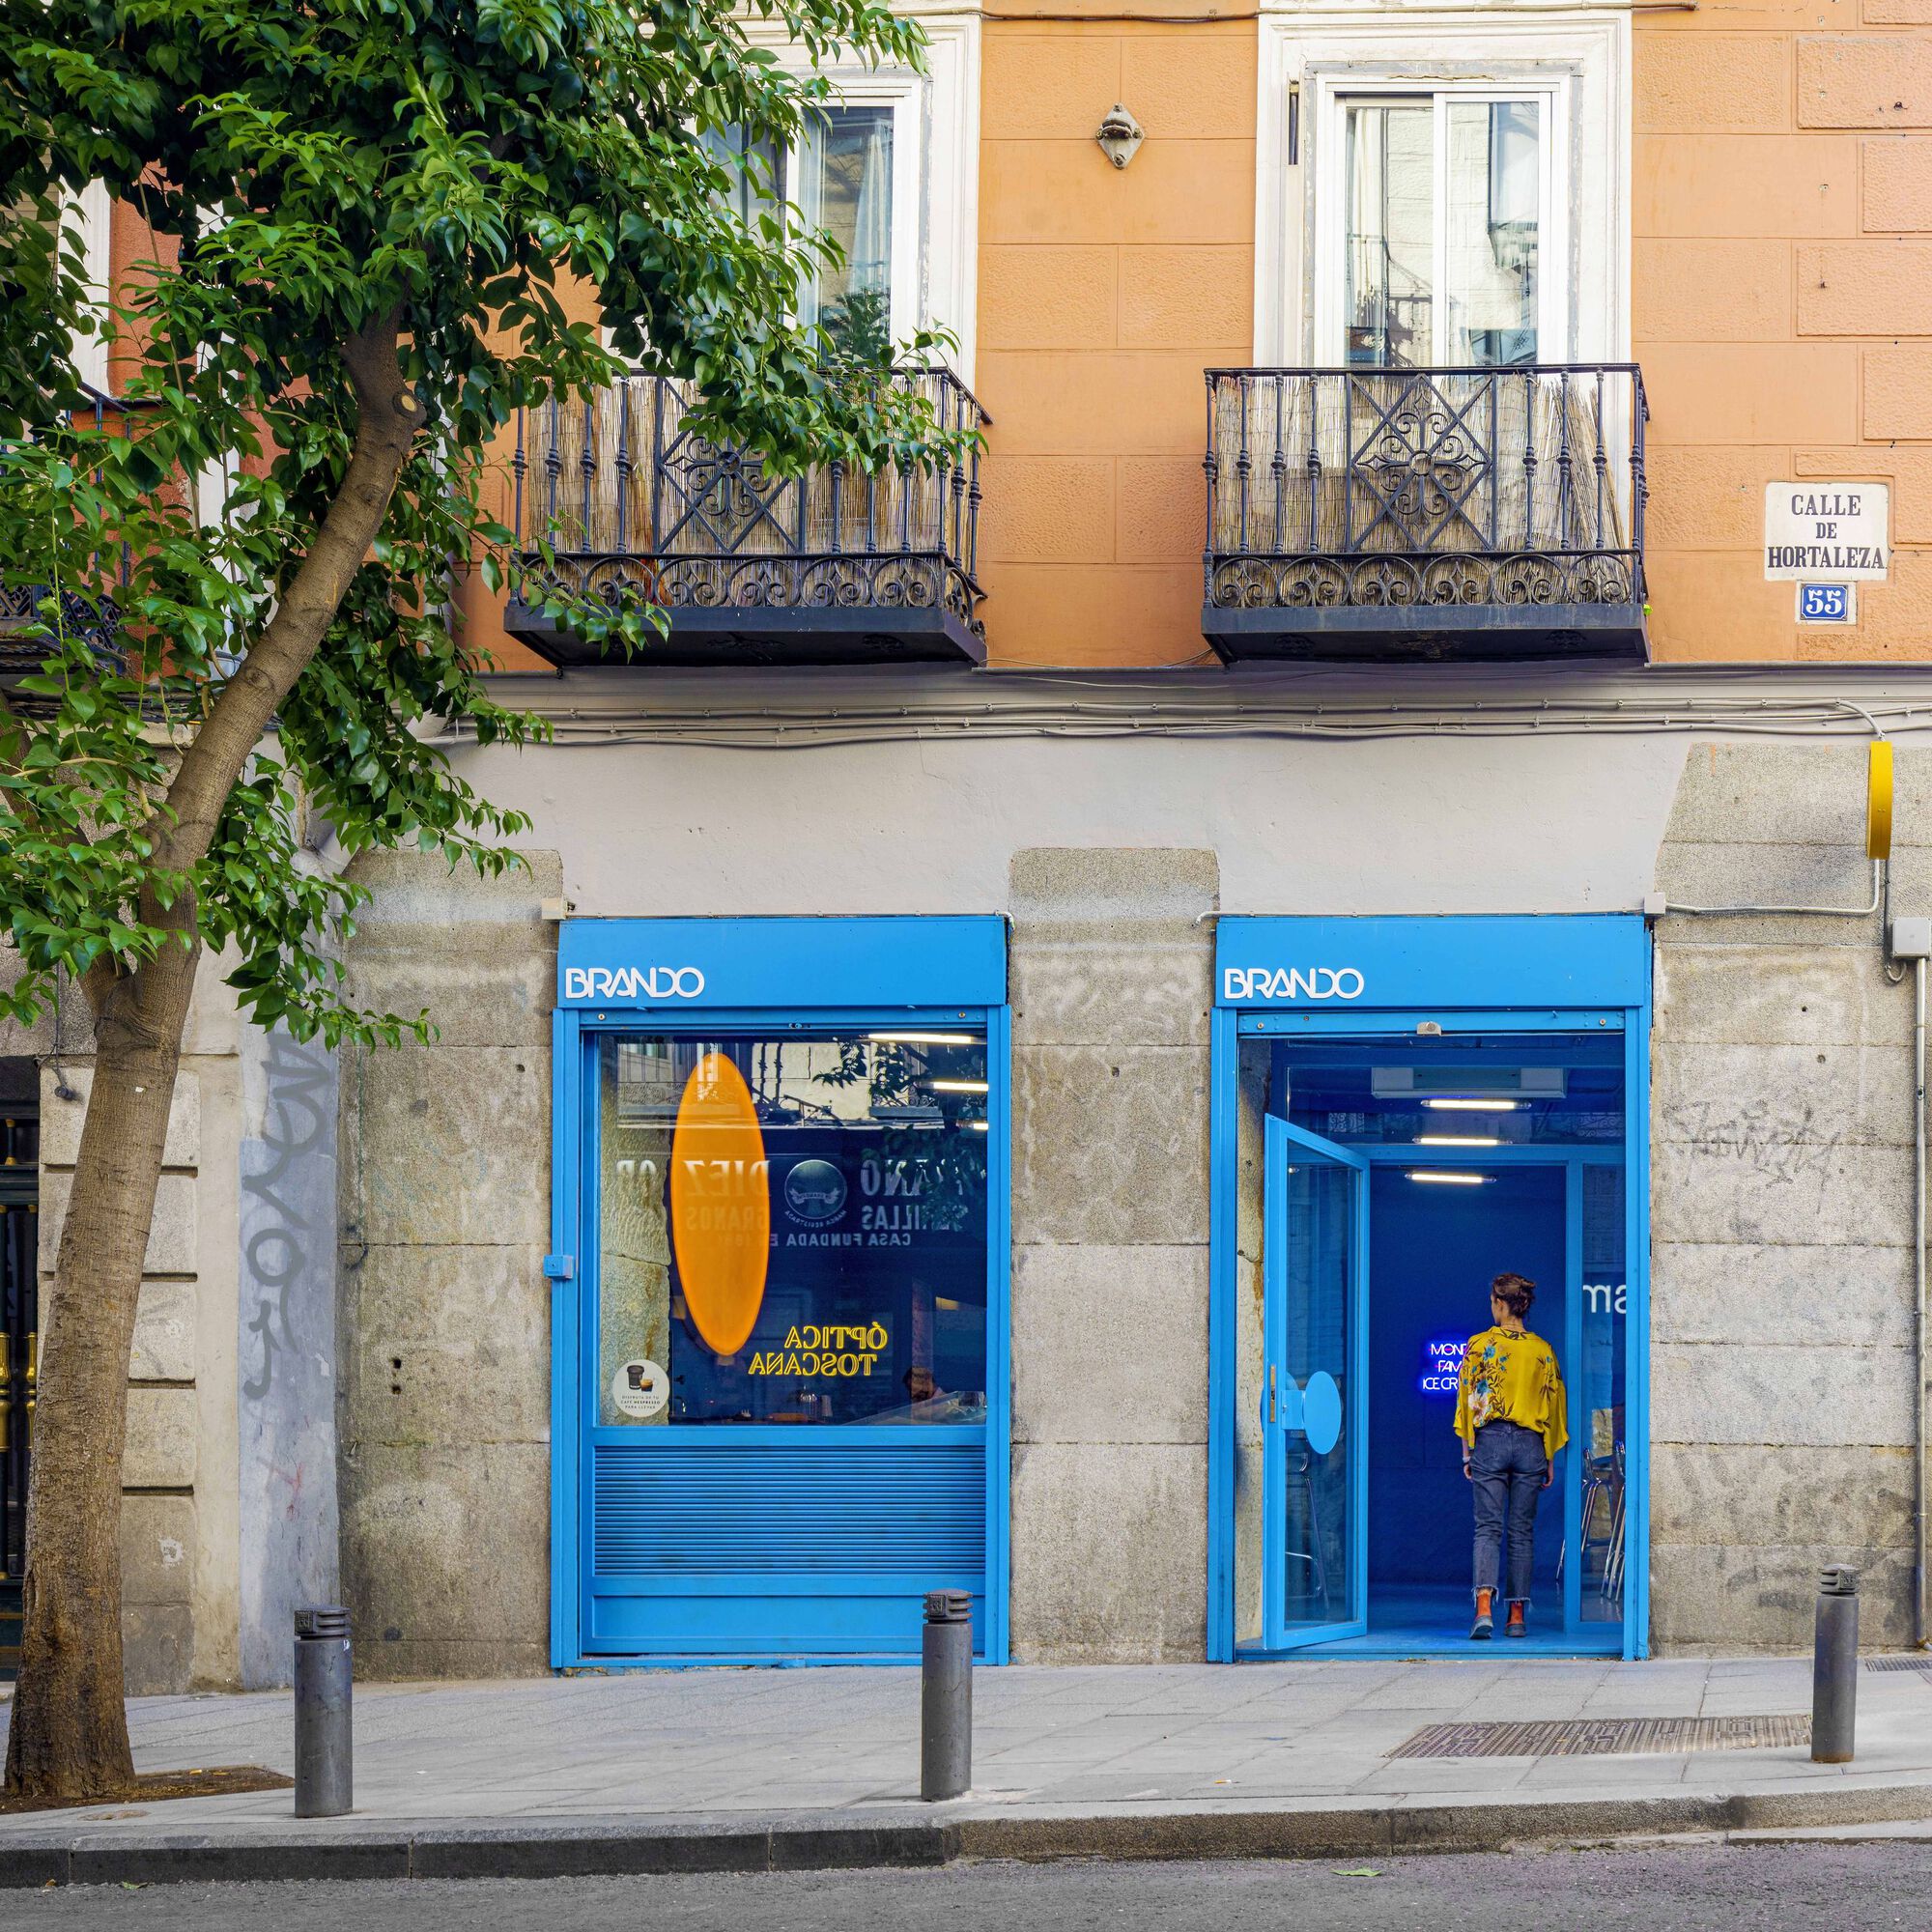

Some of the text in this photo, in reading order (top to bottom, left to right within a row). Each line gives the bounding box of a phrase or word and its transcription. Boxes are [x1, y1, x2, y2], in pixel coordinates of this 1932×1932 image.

[1791, 494, 1861, 516] CALLE
[1815, 522, 1837, 539] DE
[1805, 588, 1842, 614] 55
[565, 967, 705, 999] BRANDO
[1224, 967, 1365, 999] BRANDO
[1422, 1378, 1440, 1390] ICE
